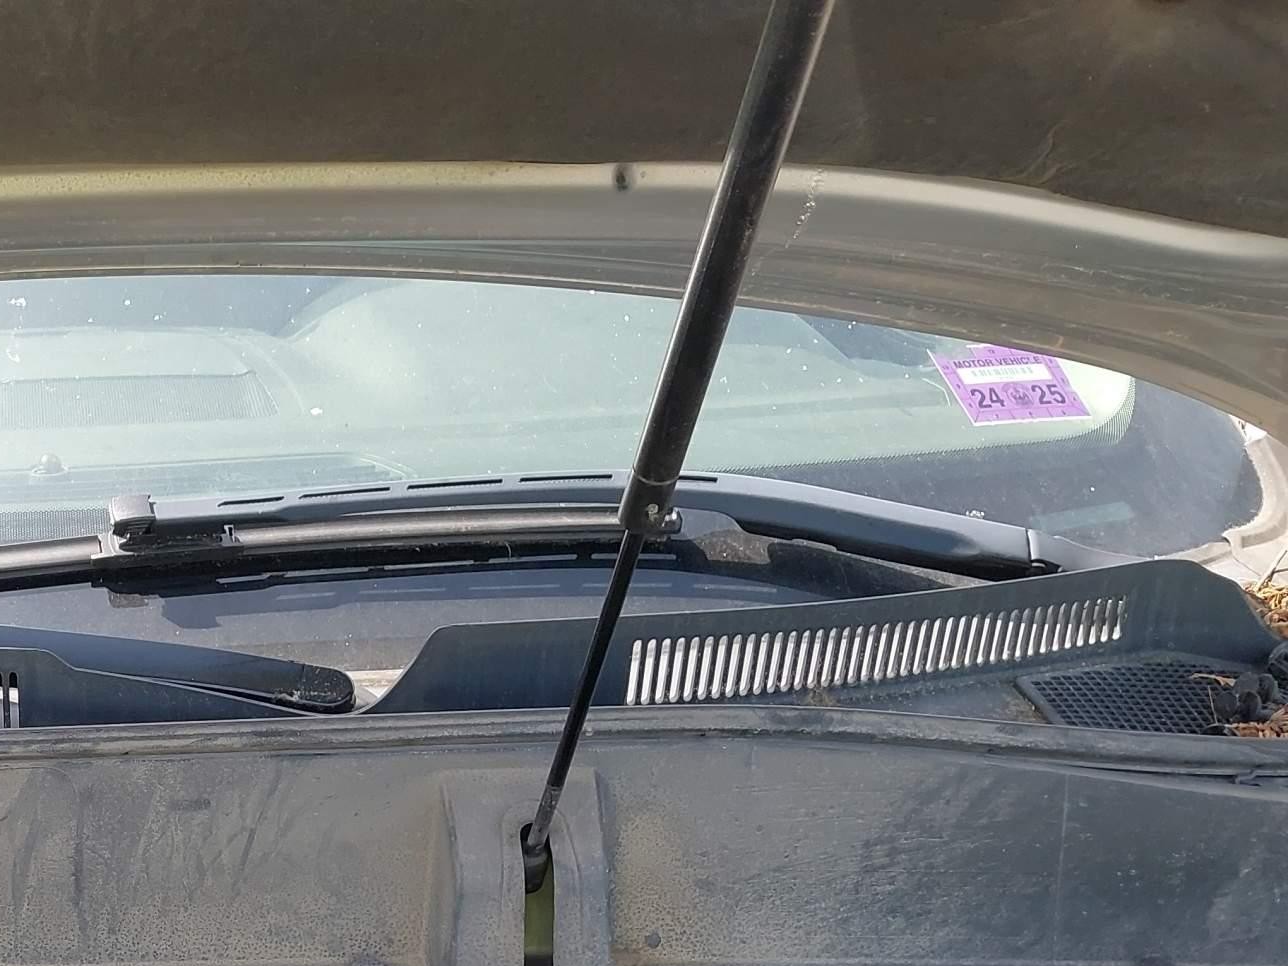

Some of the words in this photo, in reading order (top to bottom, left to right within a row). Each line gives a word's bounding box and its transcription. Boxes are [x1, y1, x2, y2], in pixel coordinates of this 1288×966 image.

[952, 359, 994, 369] MOTOR
[995, 355, 1043, 366] VEHICLE
[970, 386, 1006, 409] 24
[1030, 383, 1067, 405] 25
